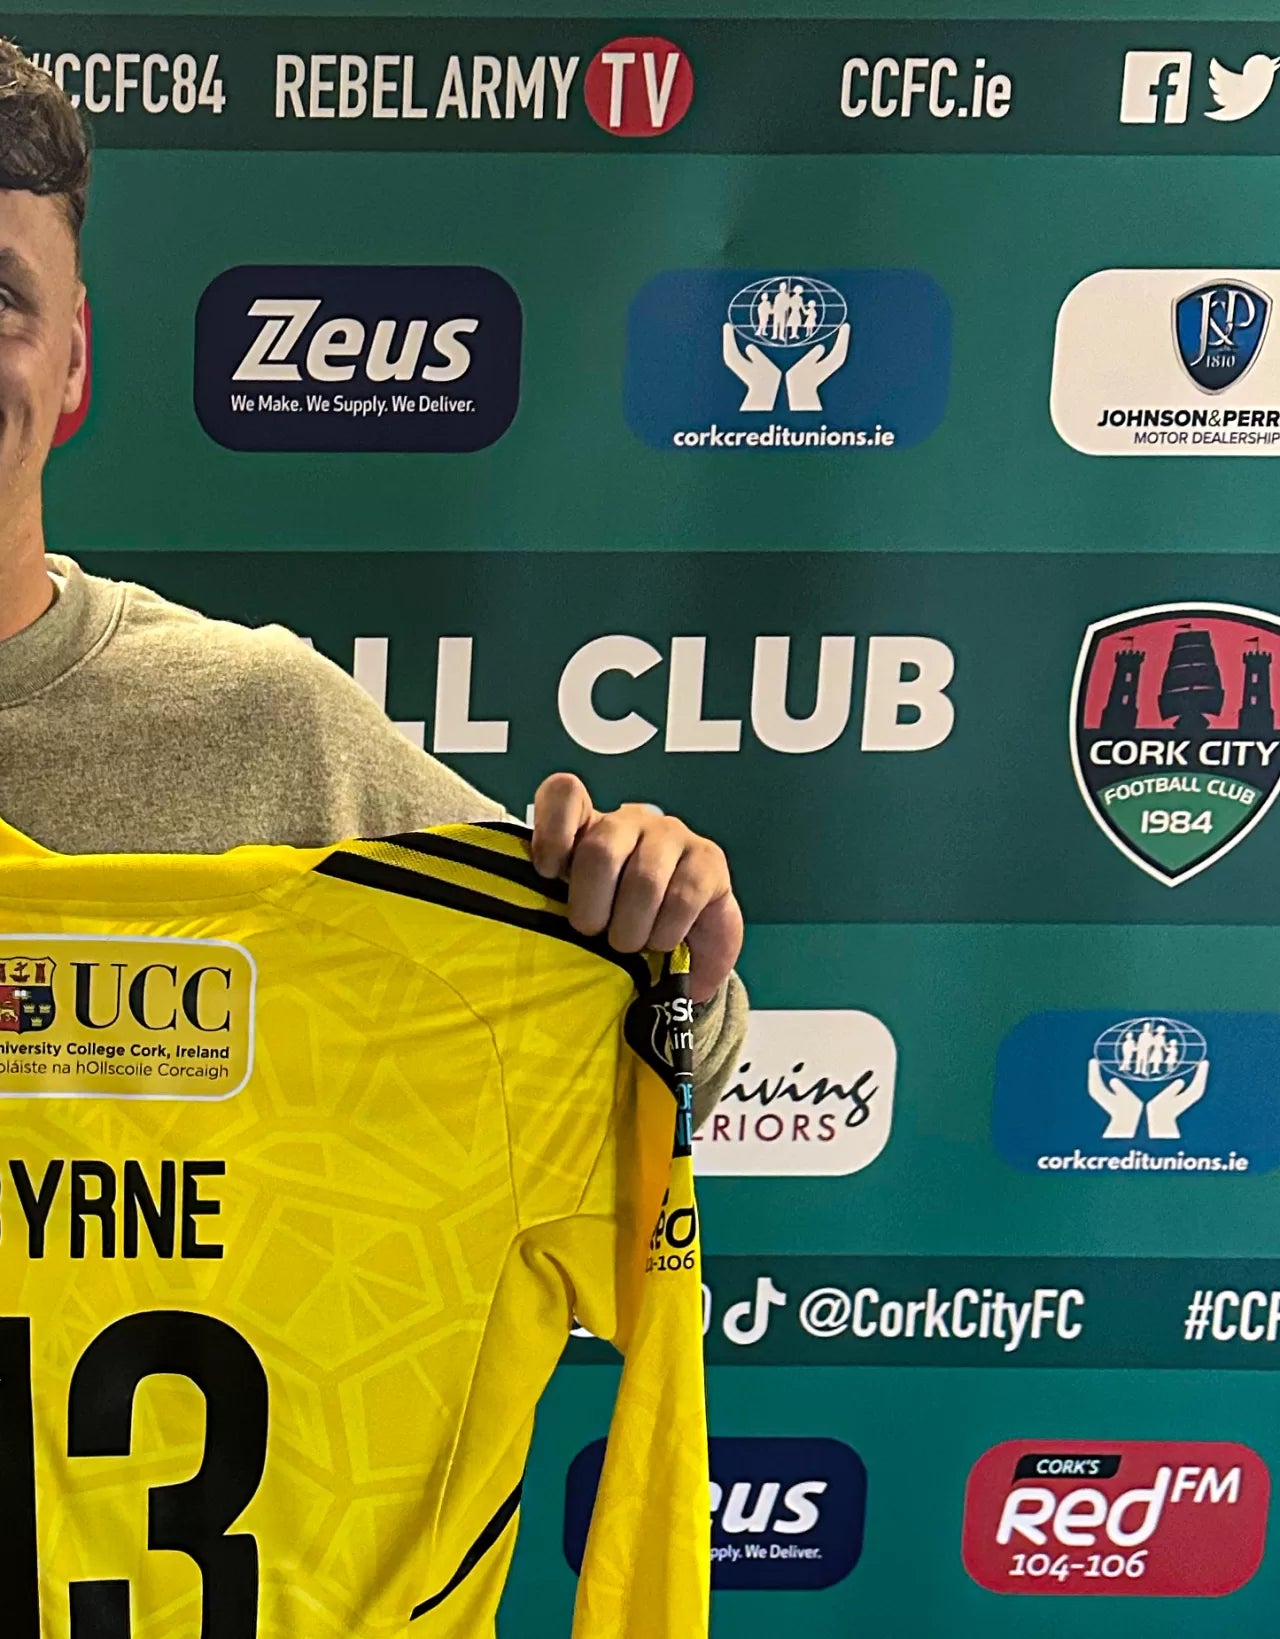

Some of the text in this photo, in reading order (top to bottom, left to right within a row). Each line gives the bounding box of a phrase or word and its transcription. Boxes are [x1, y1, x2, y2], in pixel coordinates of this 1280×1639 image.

[275, 52, 679, 128] REBEL ARMY TV
[840, 57, 1012, 118] CCFC.ie
[231, 299, 479, 382] Zeus
[1205, 355, 1235, 368] 1810
[231, 395, 476, 417] We Make. We Supply. We Deliver.
[673, 425, 895, 448] corkcreditunions.ie
[1134, 431, 1188, 444] MOTOR
[558, 634, 955, 755] CLUB
[1090, 740, 1280, 767] CORK CITY
[1104, 776, 1256, 806] FOOTBALL CLUB
[1141, 810, 1213, 834] 1984
[70, 963, 232, 1032] UCC
[67, 1042, 124, 1058] College
[130, 1044, 170, 1059] Cork,
[176, 1044, 229, 1059] Ireland
[52, 1063, 70, 1075] na
[158, 1062, 229, 1080] Corcaigh
[693, 1113, 836, 1142] RIORS
[1038, 1151, 1248, 1172] corkcreditunions.ie
[800, 1287, 1084, 1352] @CorkCityFC
[1036, 1459, 1100, 1475] CORK'S
[745, 1544, 767, 1559] We
[770, 1544, 822, 1559] Deliver.
[1009, 1549, 1148, 1582] 104-106
